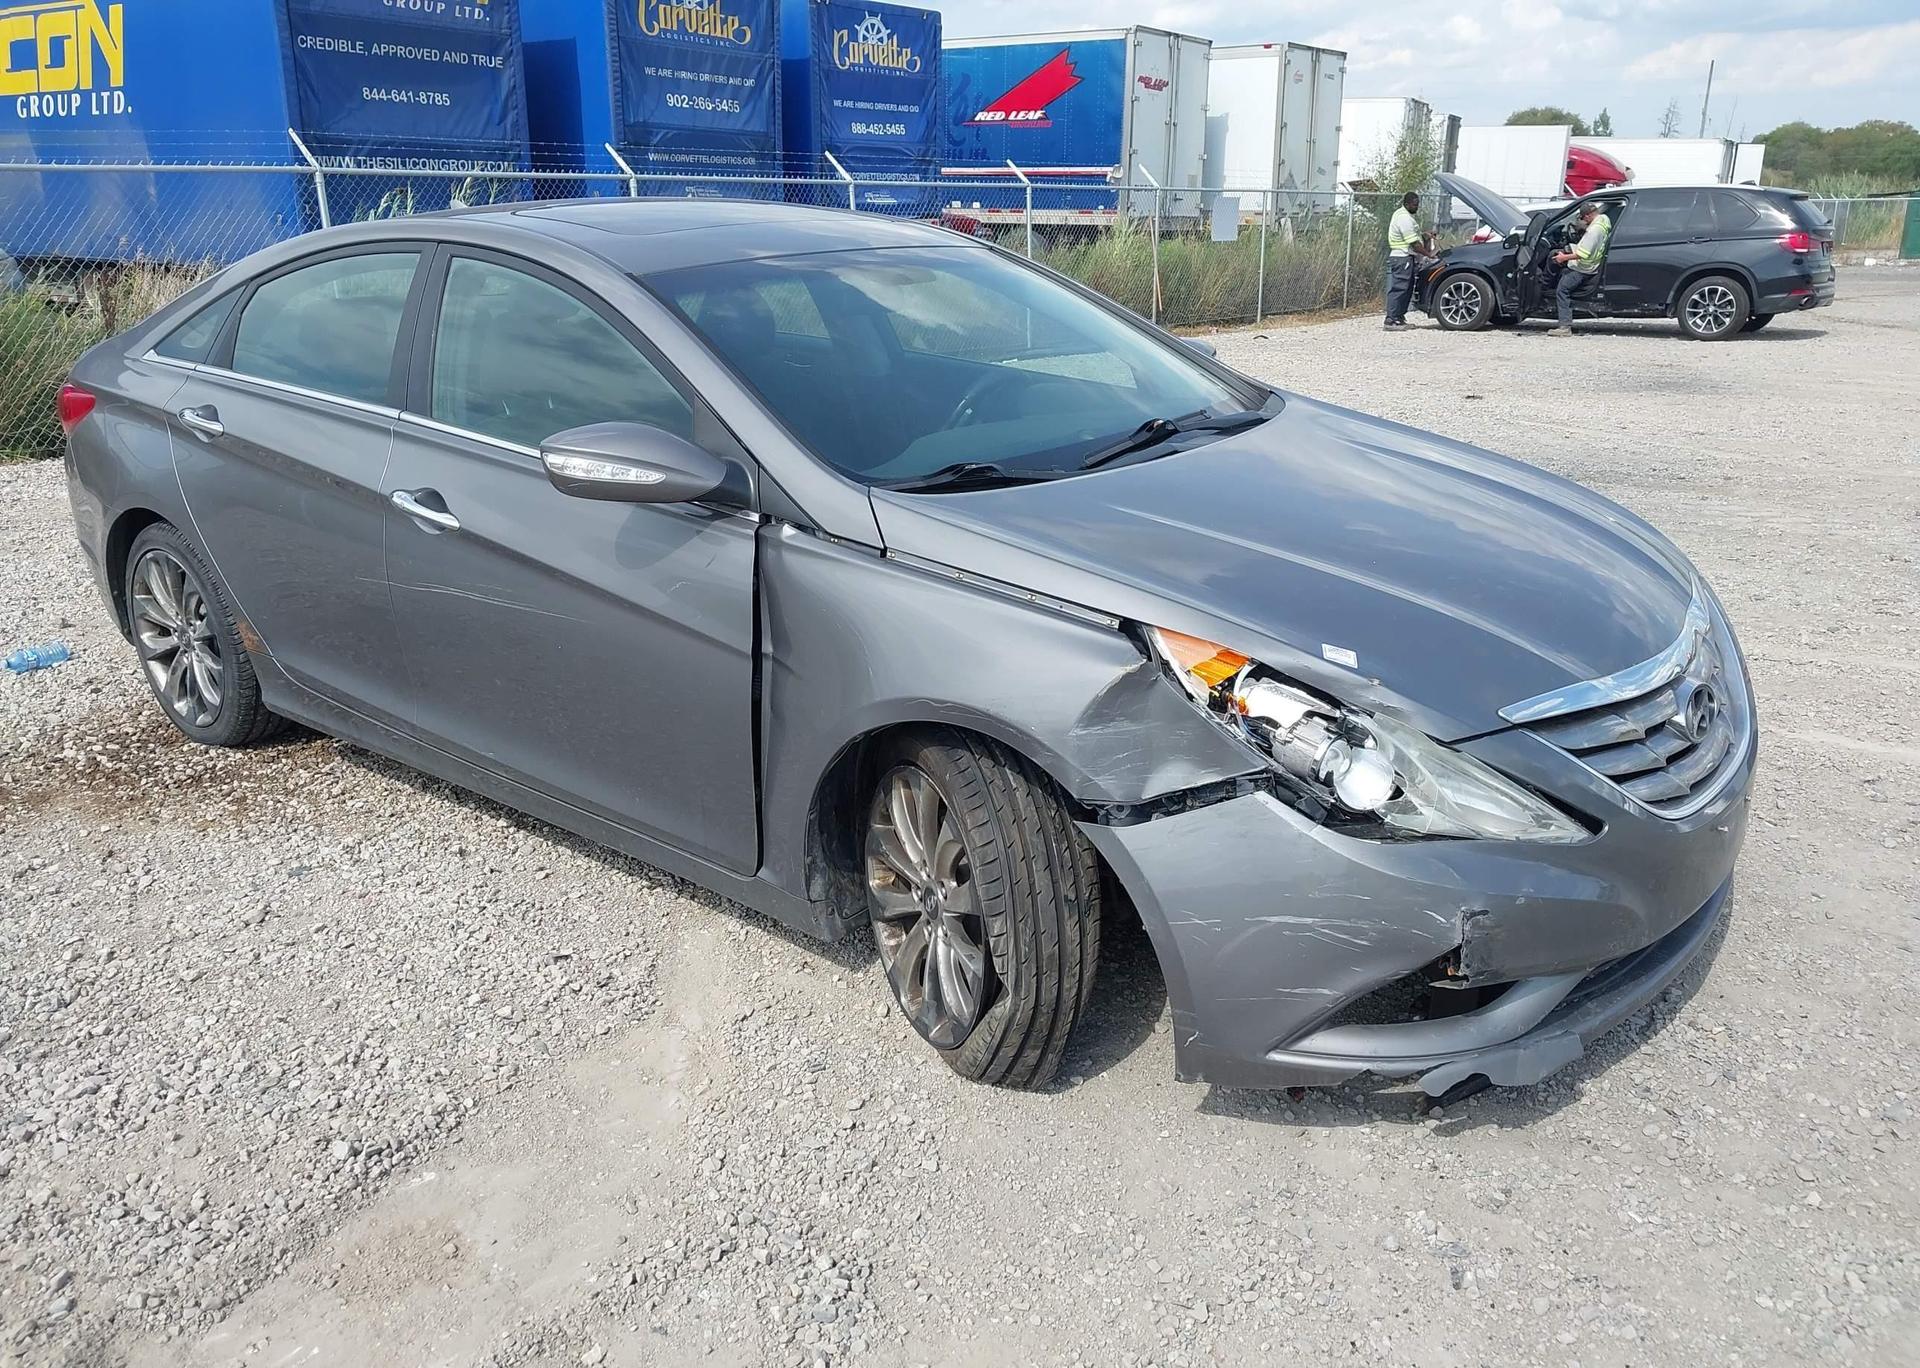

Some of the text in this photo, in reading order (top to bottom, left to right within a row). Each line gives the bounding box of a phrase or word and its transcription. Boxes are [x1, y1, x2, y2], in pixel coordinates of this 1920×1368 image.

[455, 5, 490, 21] LTD.
[661, 31, 710, 45] LOGISTICS
[297, 35, 504, 69] CREDIBLE, APPROVED AND TRUE
[833, 28, 921, 73] Corvette
[644, 66, 657, 76] WE
[657, 68, 673, 78] ARE
[674, 70, 698, 81] HIRING
[699, 73, 728, 84] DRIVERS
[728, 77, 742, 86] AND
[850, 66, 889, 75] LOGISTICS
[16, 90, 133, 118] GROUP LTD.
[362, 86, 450, 106] 844-641-8785
[666, 93, 740, 113] 902-266-5455
[843, 100, 854, 108] ARE
[855, 101, 873, 110] HIRING
[874, 102, 897, 111] DRIVERS
[974, 110, 1046, 121] RED LEAF
[851, 122, 906, 135] 888-452-5455
